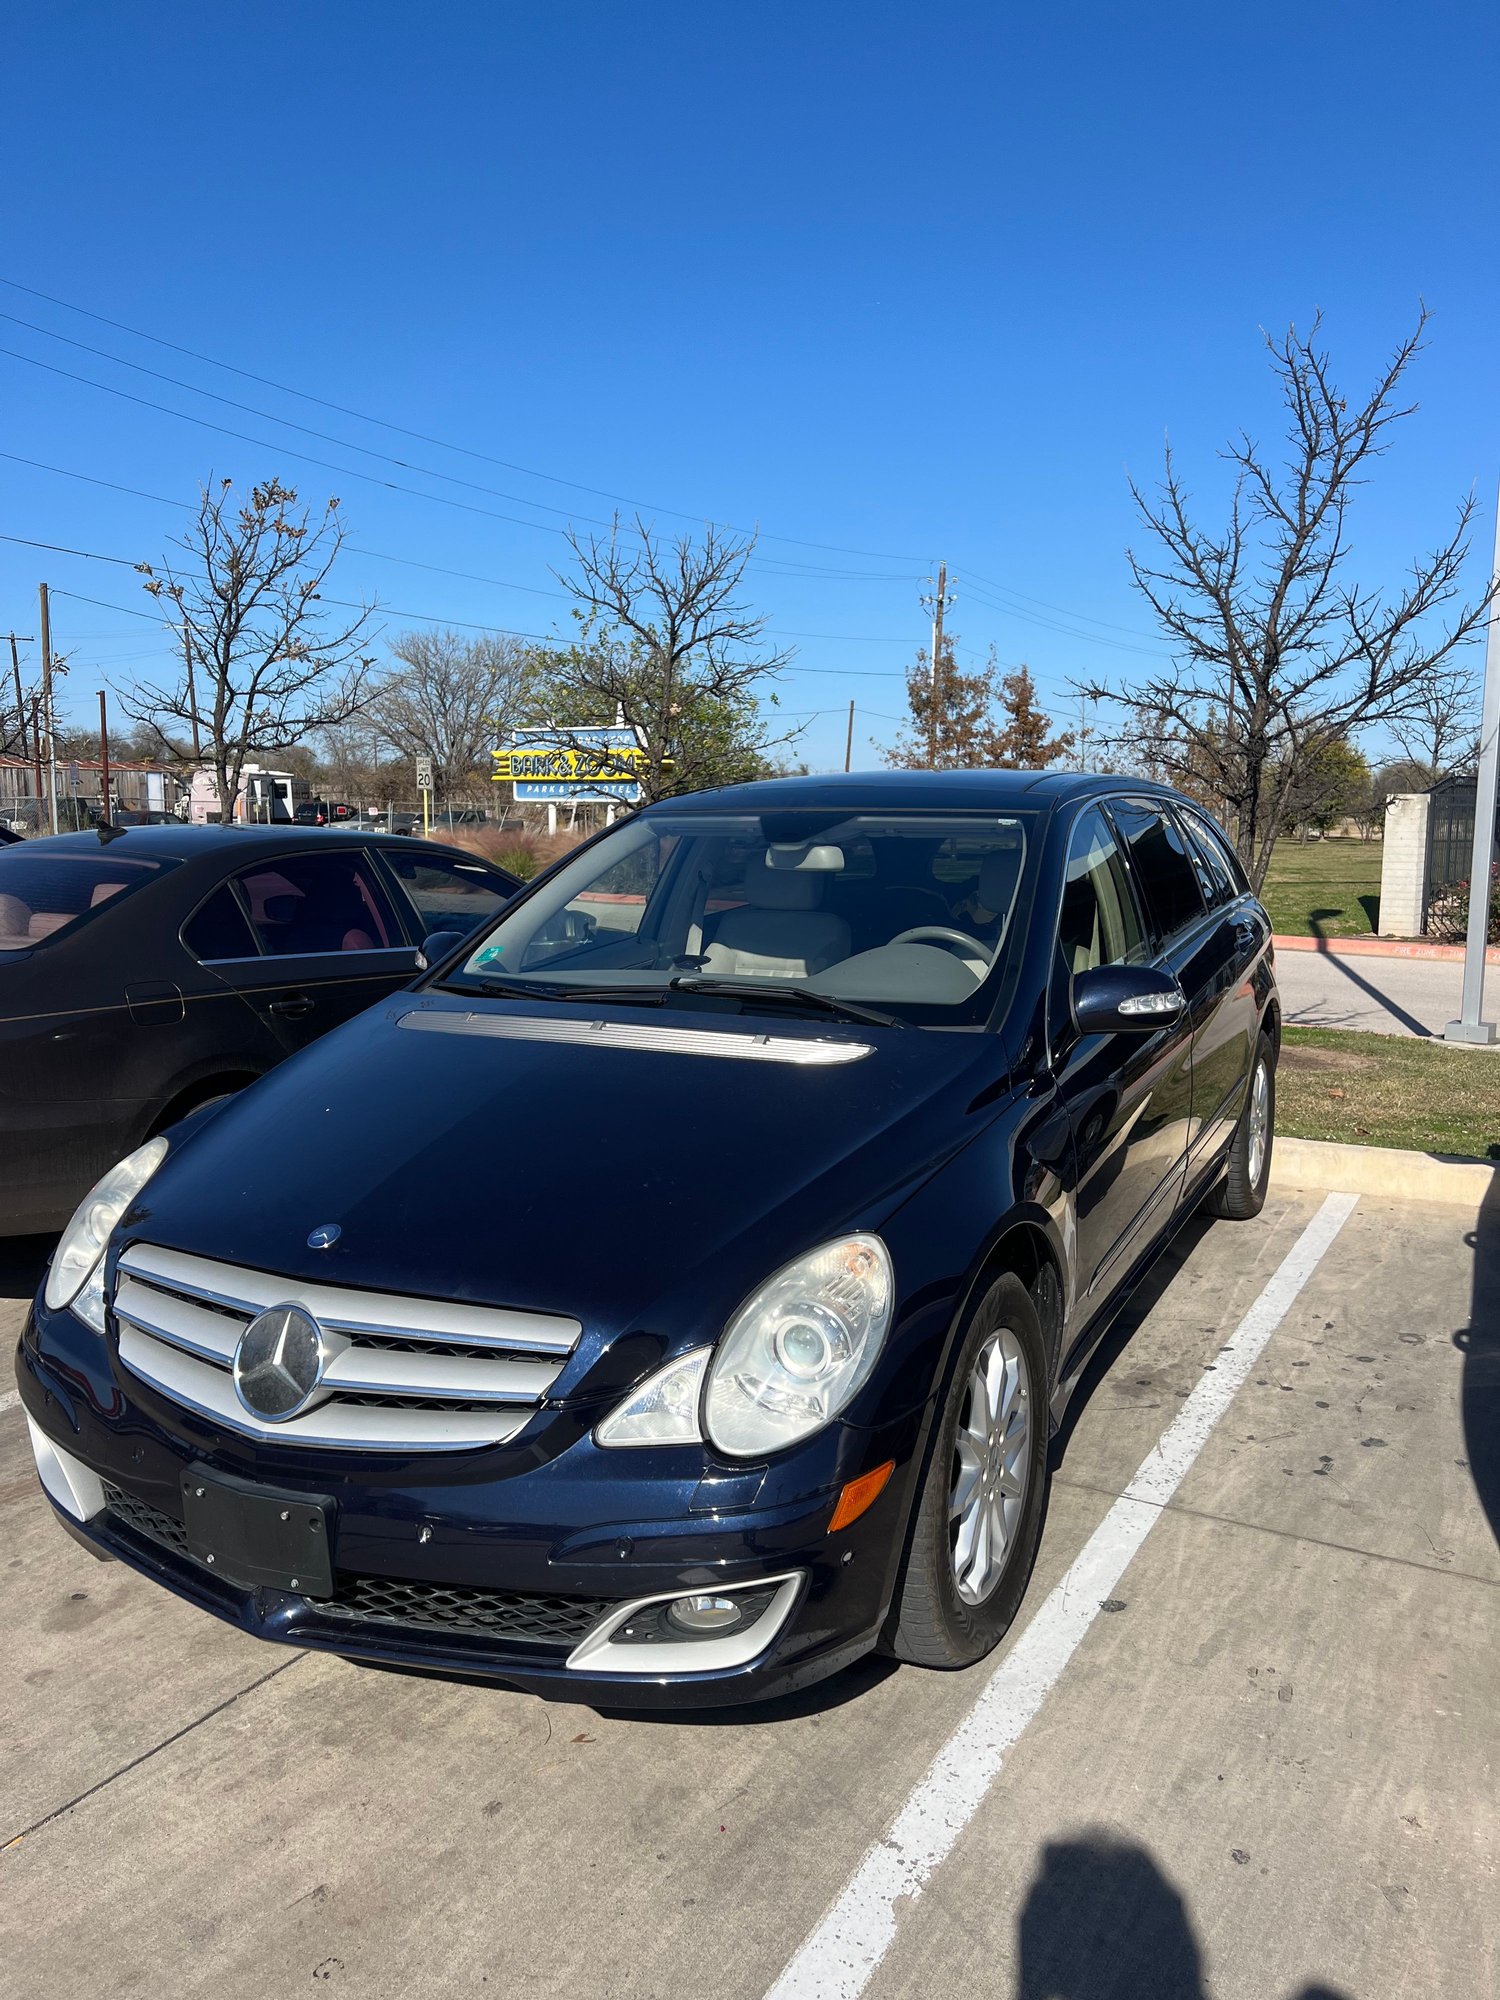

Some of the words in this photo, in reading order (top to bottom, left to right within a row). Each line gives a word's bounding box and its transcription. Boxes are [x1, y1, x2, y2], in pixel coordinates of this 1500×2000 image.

[511, 754, 558, 776] BARK
[418, 773, 430, 785] 20
[526, 784, 556, 793] PARK
[558, 785, 566, 793] &
